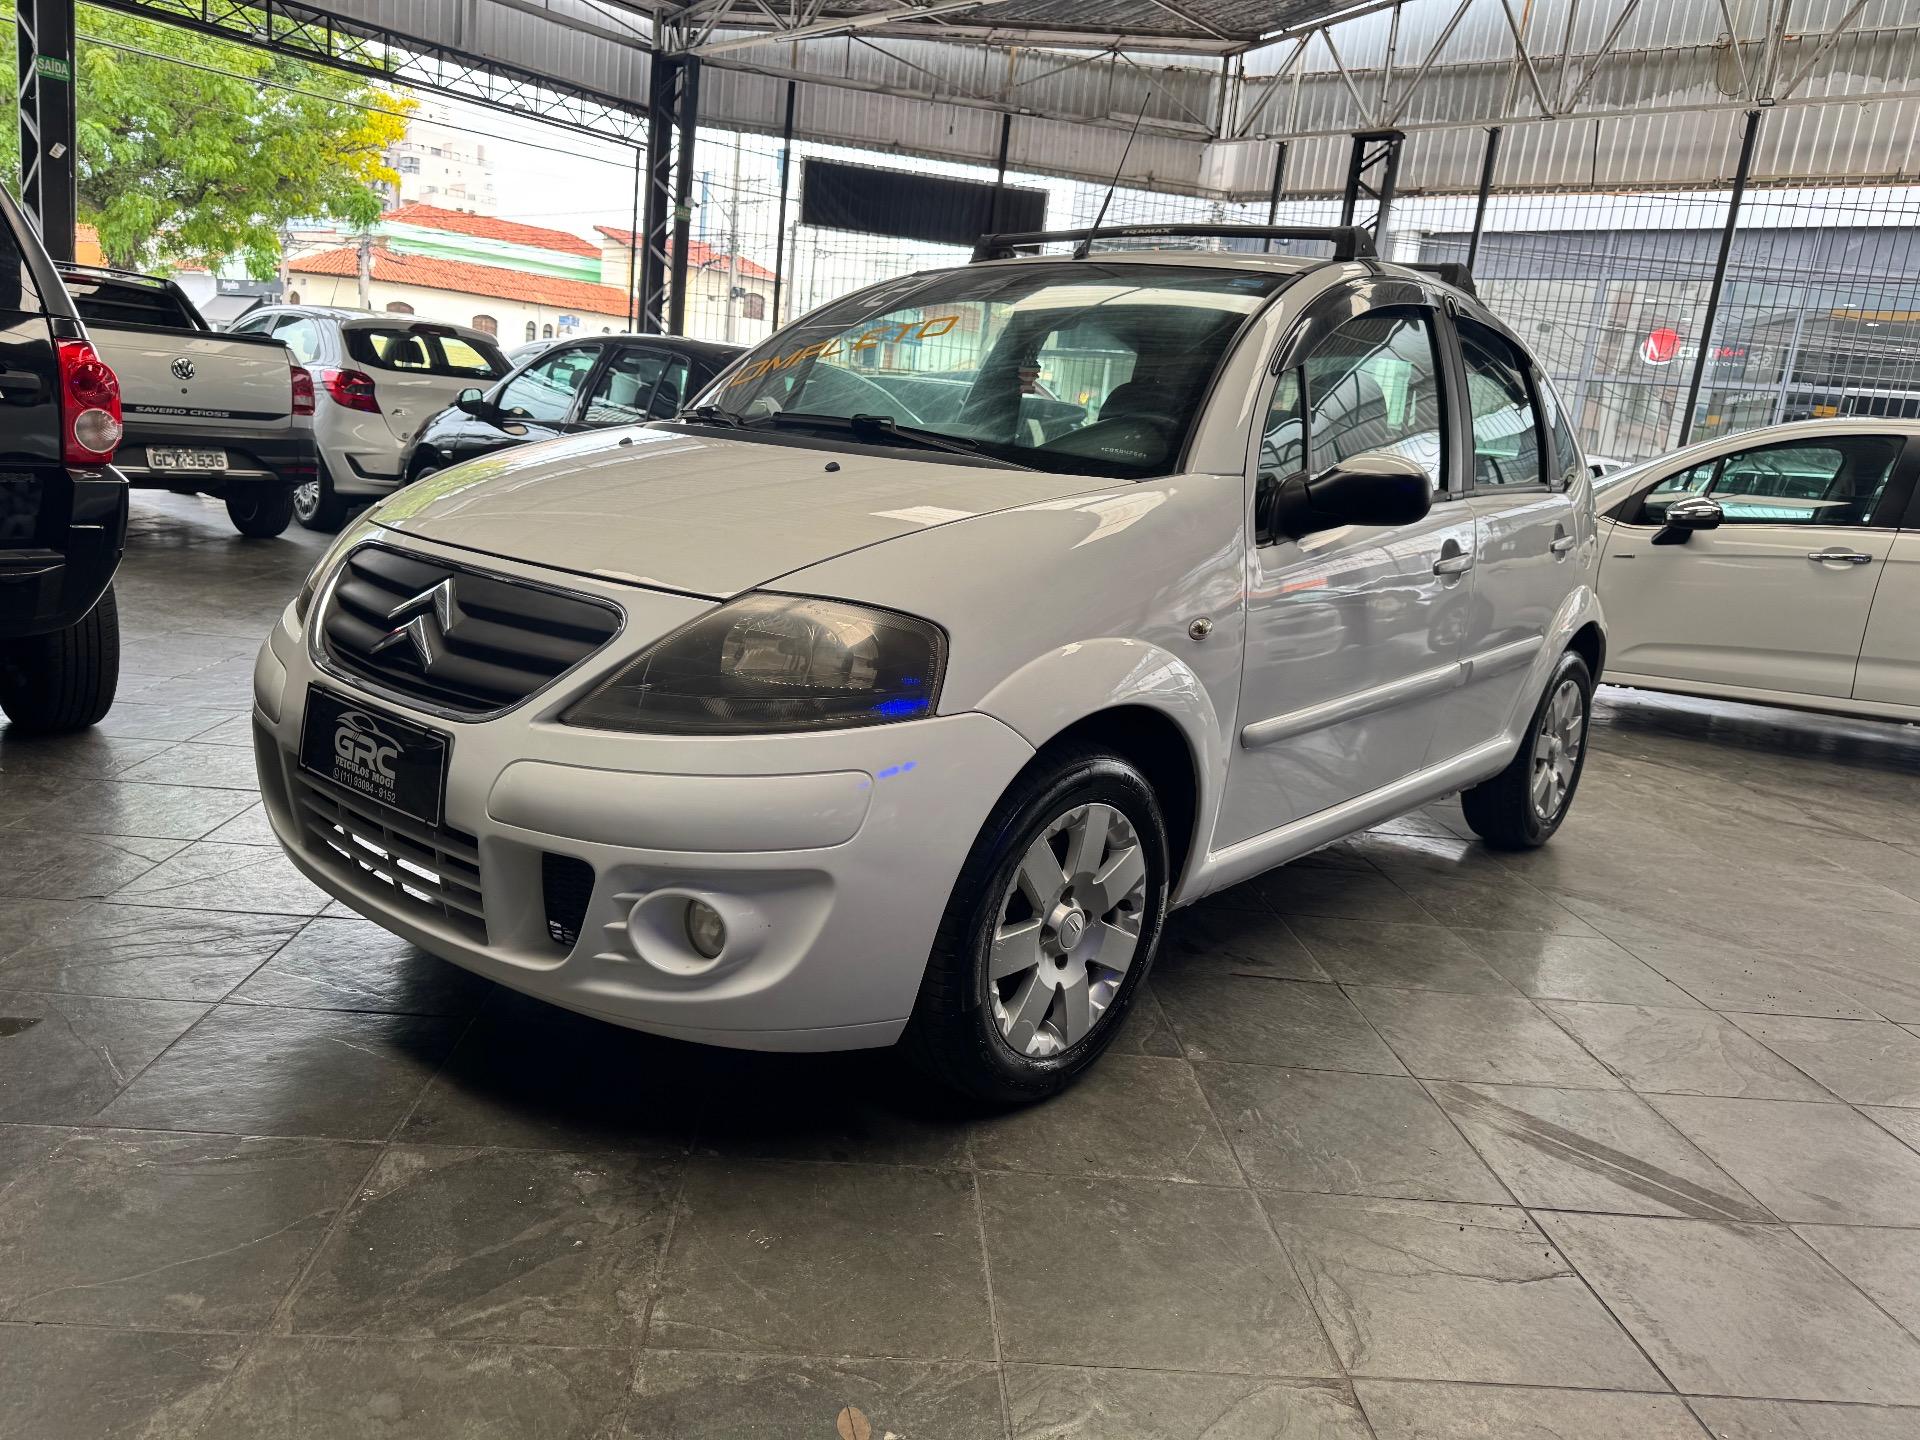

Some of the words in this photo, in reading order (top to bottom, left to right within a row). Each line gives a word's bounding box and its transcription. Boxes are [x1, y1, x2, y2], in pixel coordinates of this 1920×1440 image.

[38, 57, 68, 75] SAÍDA
[730, 315, 960, 388] OMPLETO
[135, 406, 187, 415] SAVEIRO
[189, 409, 230, 418] CROSS
[335, 727, 398, 780] GRC
[371, 771, 395, 790] MOGI
[378, 787, 396, 804] 9152
